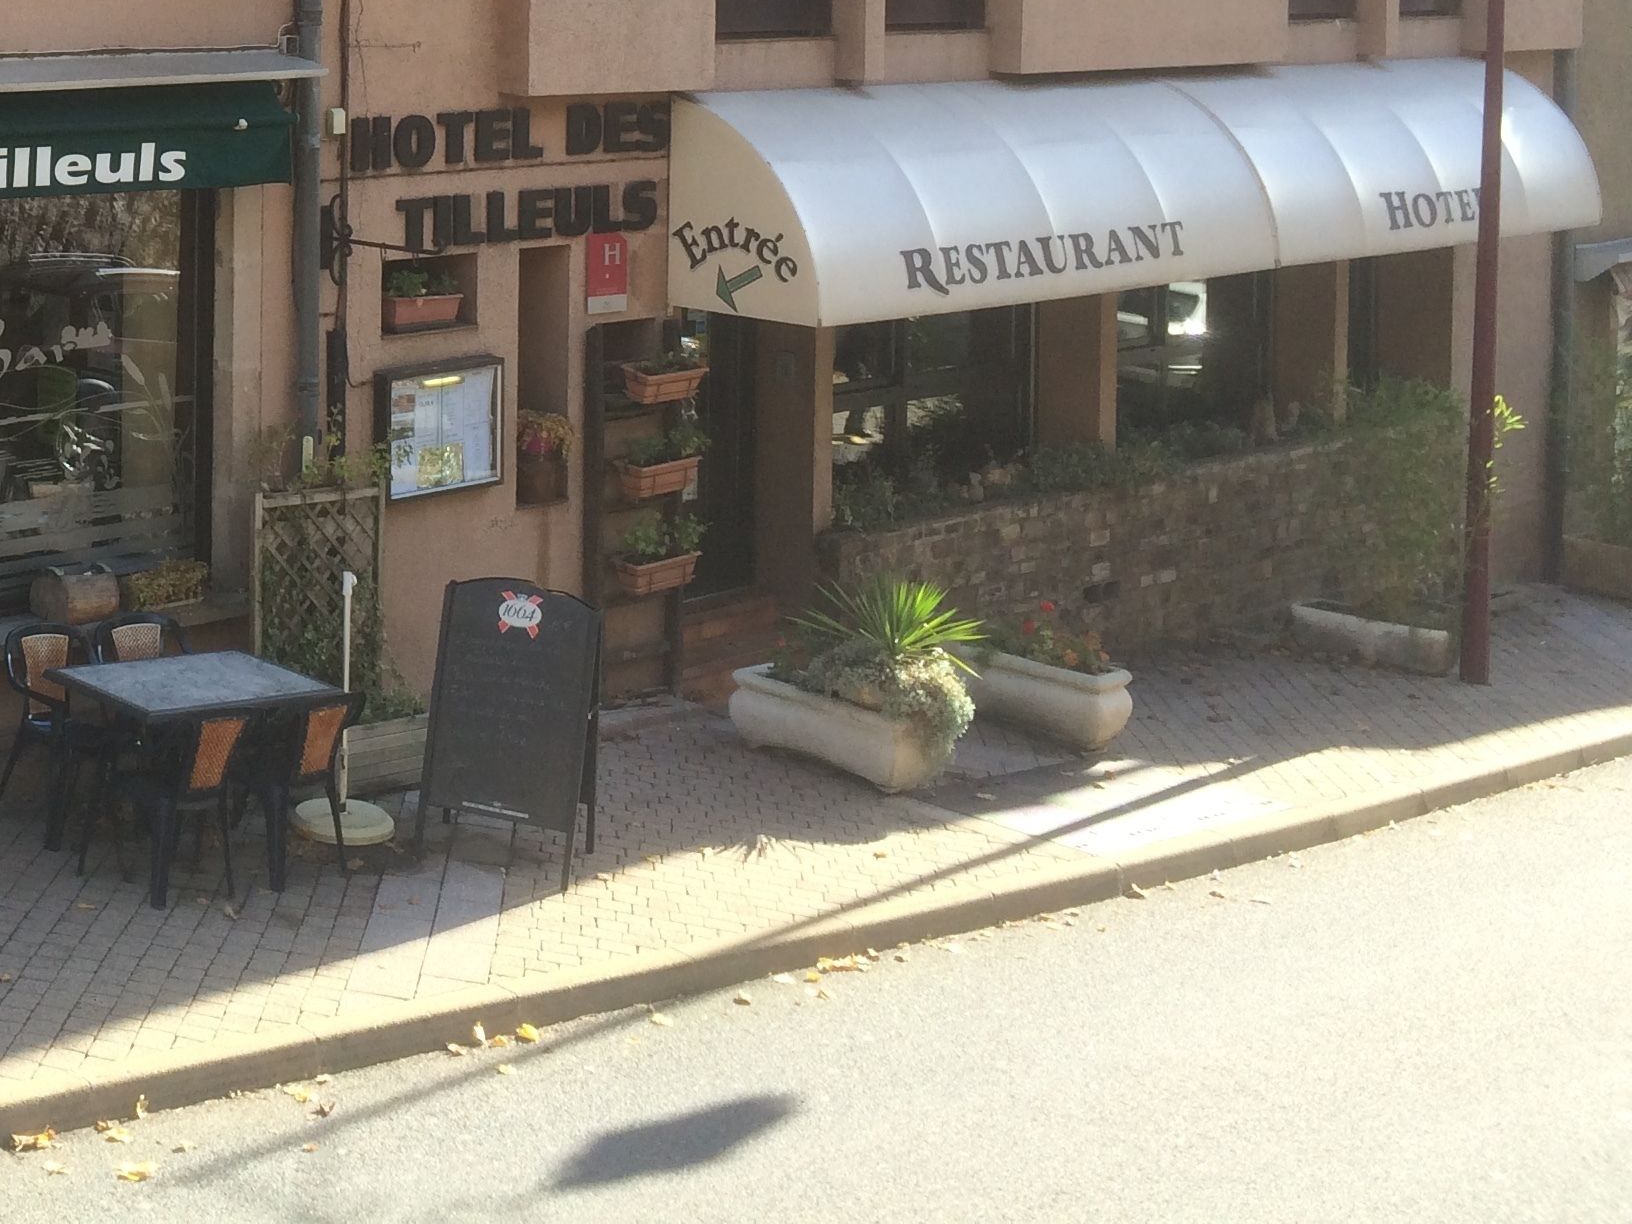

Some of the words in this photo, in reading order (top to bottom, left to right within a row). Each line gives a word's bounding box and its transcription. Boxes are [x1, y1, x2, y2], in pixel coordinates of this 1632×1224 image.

[351, 108, 544, 171] HOTEL
[566, 100, 670, 155] DES
[395, 180, 658, 251] TILLEULS
[671, 216, 798, 283] Entrée
[603, 242, 621, 265] H
[901, 220, 1184, 297] RESTAURANT
